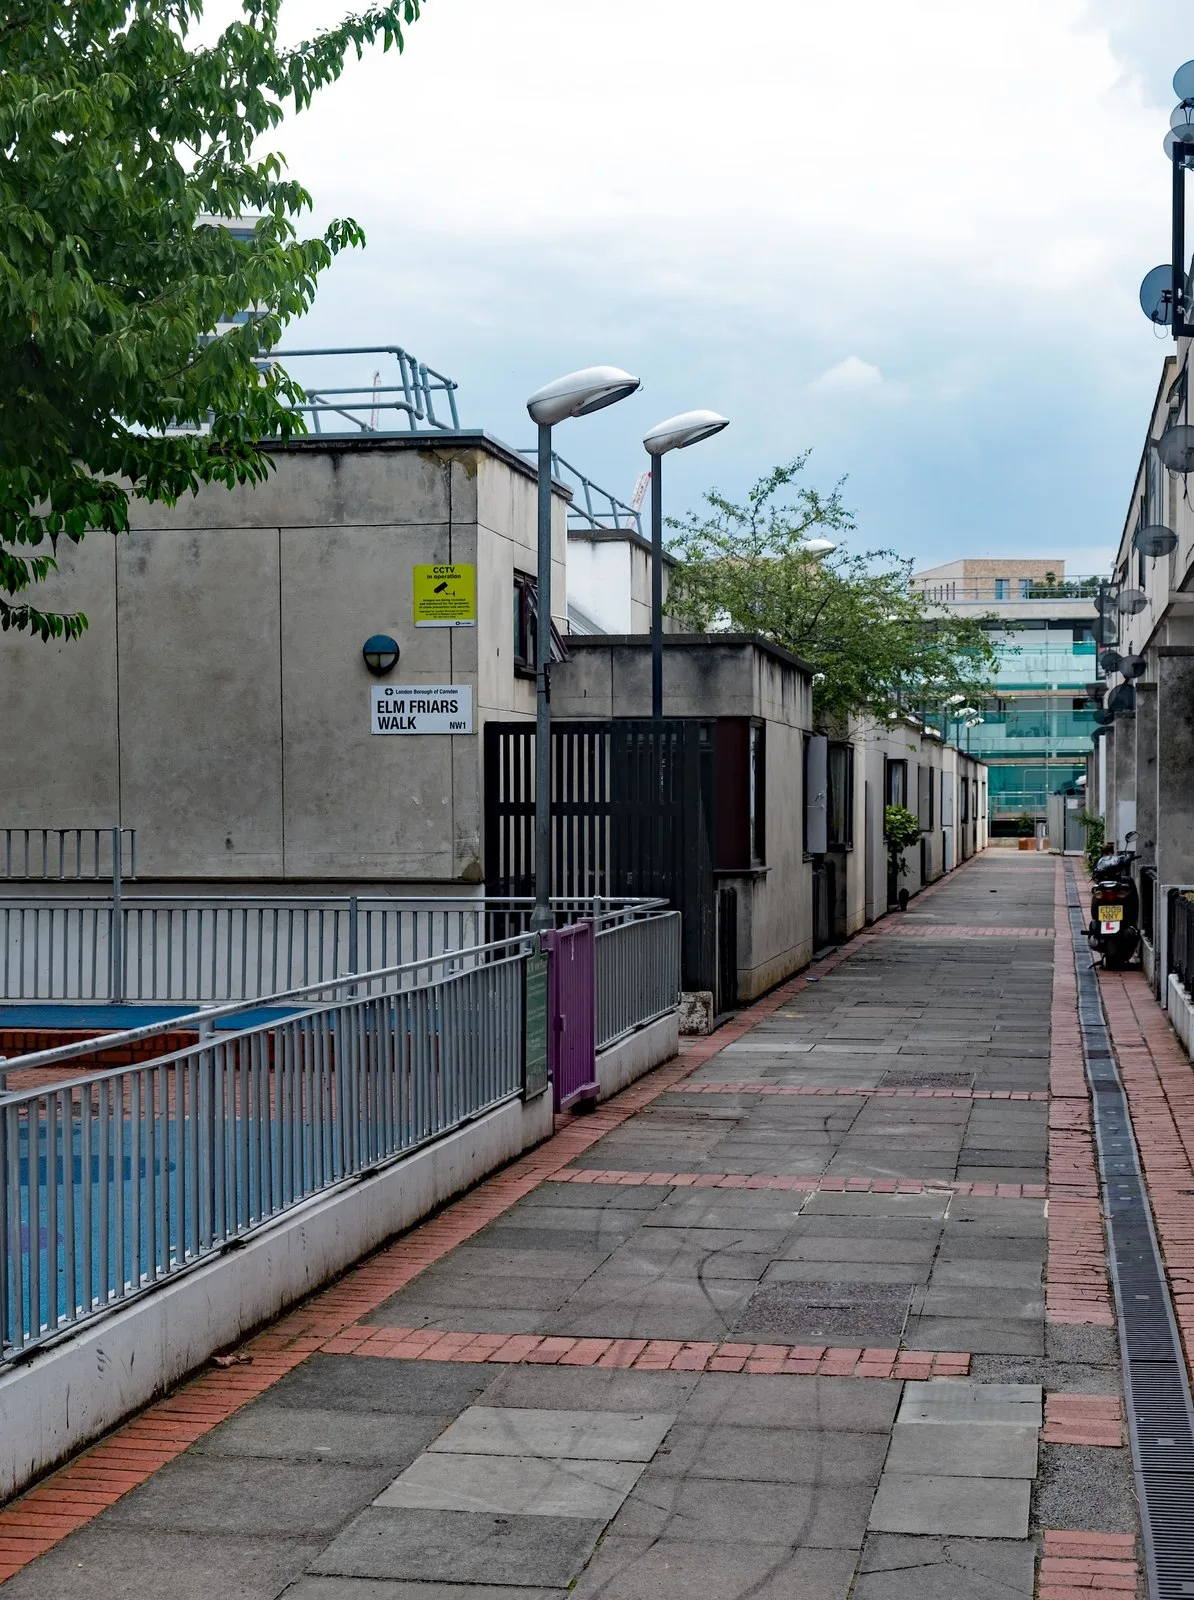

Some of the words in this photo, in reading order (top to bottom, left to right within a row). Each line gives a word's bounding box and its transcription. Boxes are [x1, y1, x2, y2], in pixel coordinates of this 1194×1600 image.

[377, 700, 405, 713] ELM
[409, 700, 459, 713] FRIARS
[378, 716, 417, 730] WALK
[449, 721, 466, 729] NW1
[1106, 922, 1115, 930] L
